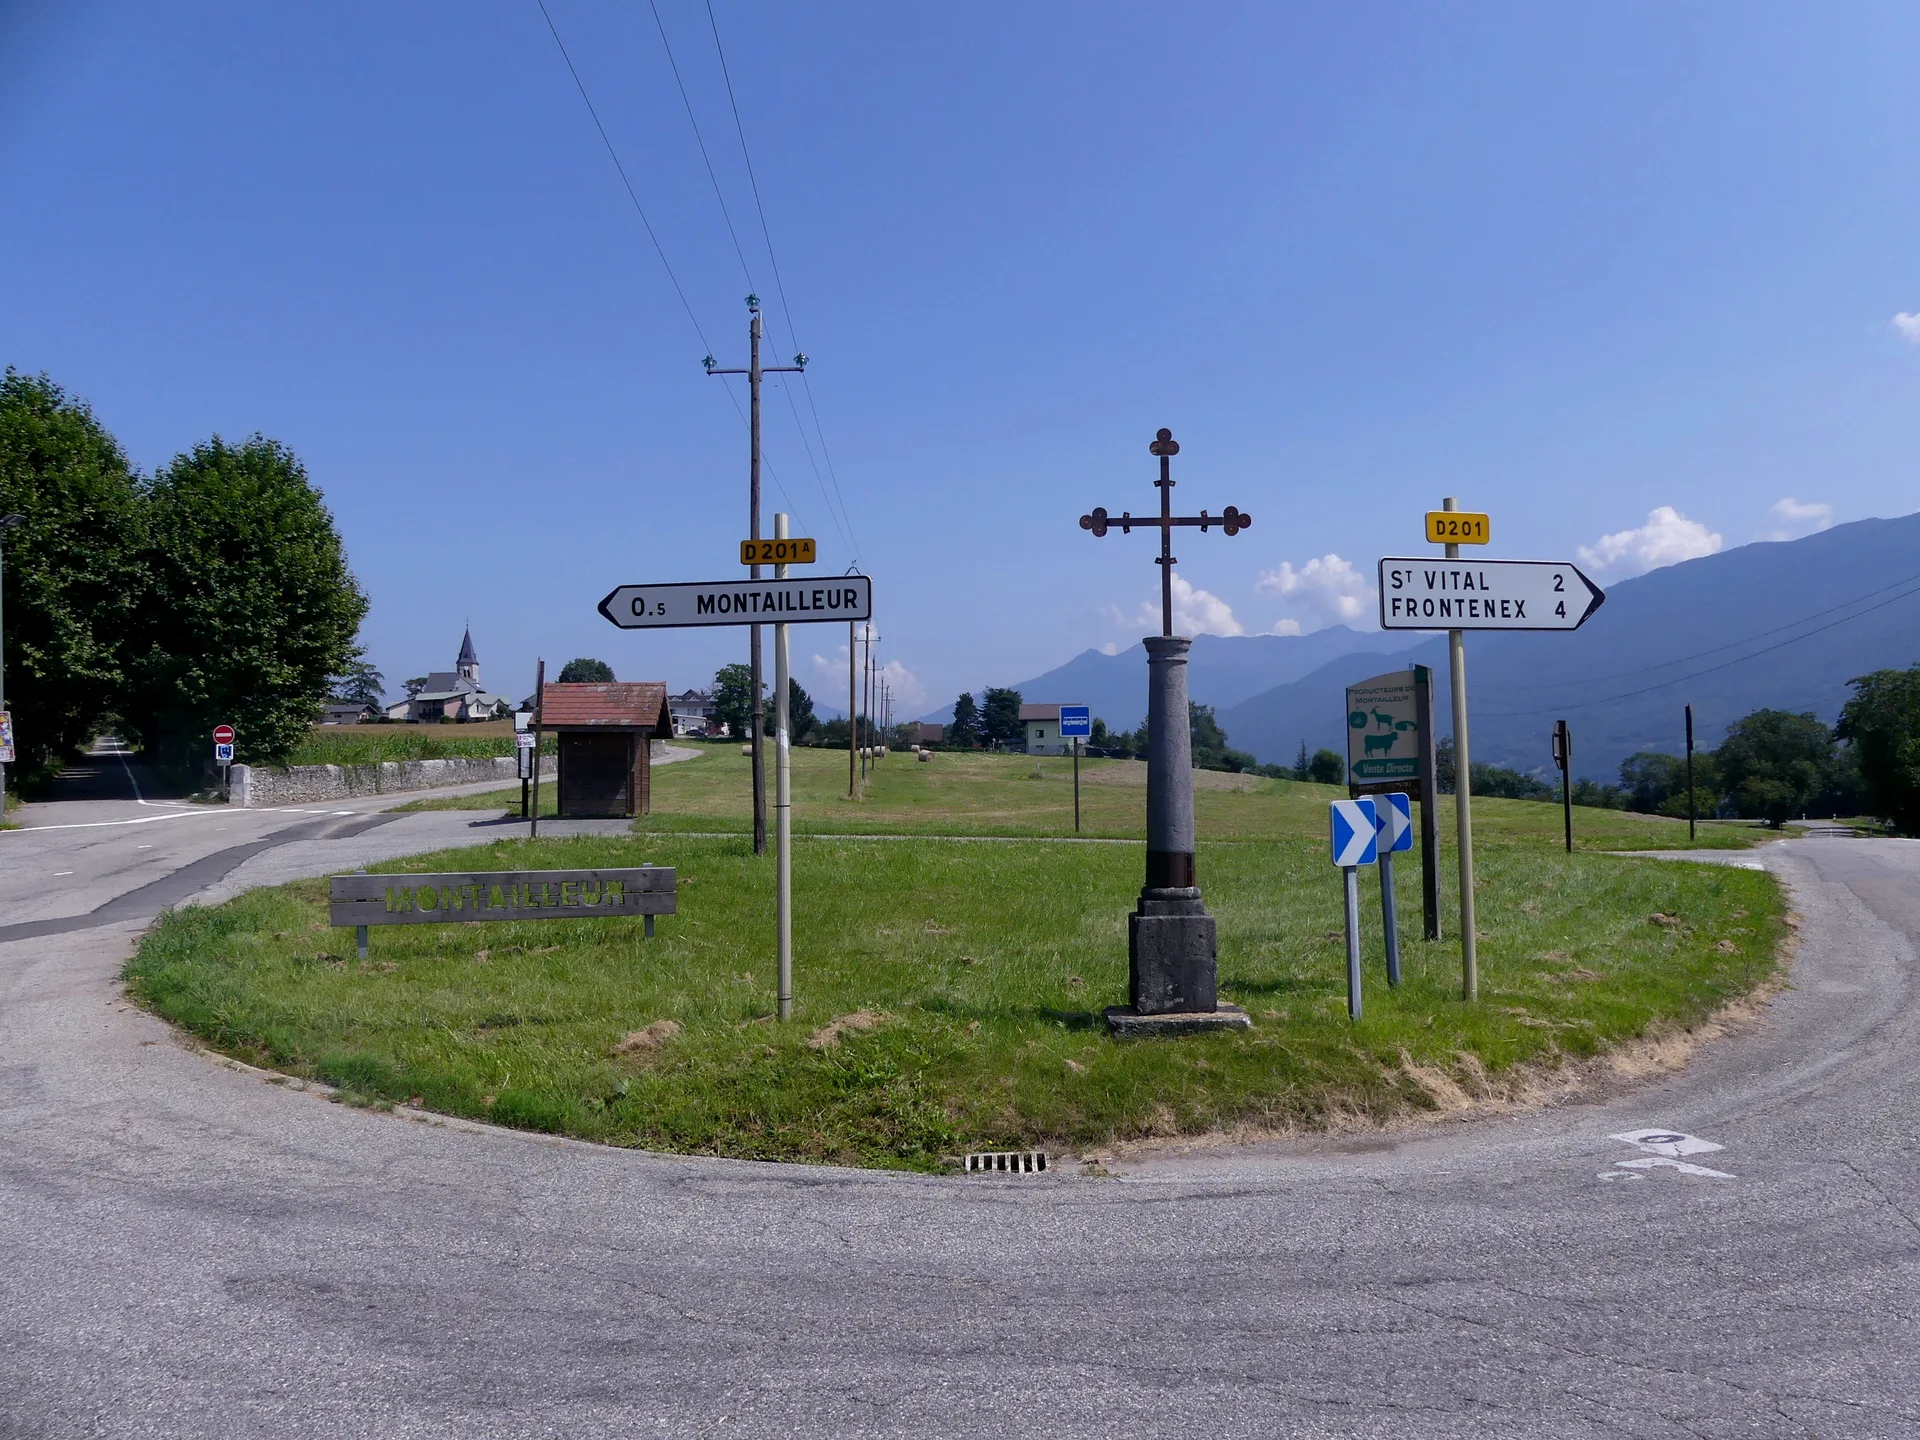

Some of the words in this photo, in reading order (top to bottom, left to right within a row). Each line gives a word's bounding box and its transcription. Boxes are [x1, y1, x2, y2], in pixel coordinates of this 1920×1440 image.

[1436, 520, 1482, 537] D201
[1425, 570, 1490, 591] VITAL
[1553, 574, 1565, 592] 2
[697, 588, 858, 615] MONTAILLEUR
[1391, 598, 1526, 619] FRONTENEX
[1555, 600, 1566, 619] 4
[1355, 695, 1409, 704] MONTAILLEUR
[1363, 763, 1384, 774] Vente
[1386, 762, 1414, 773] Directe
[385, 879, 626, 913] MONTAILLEUR
